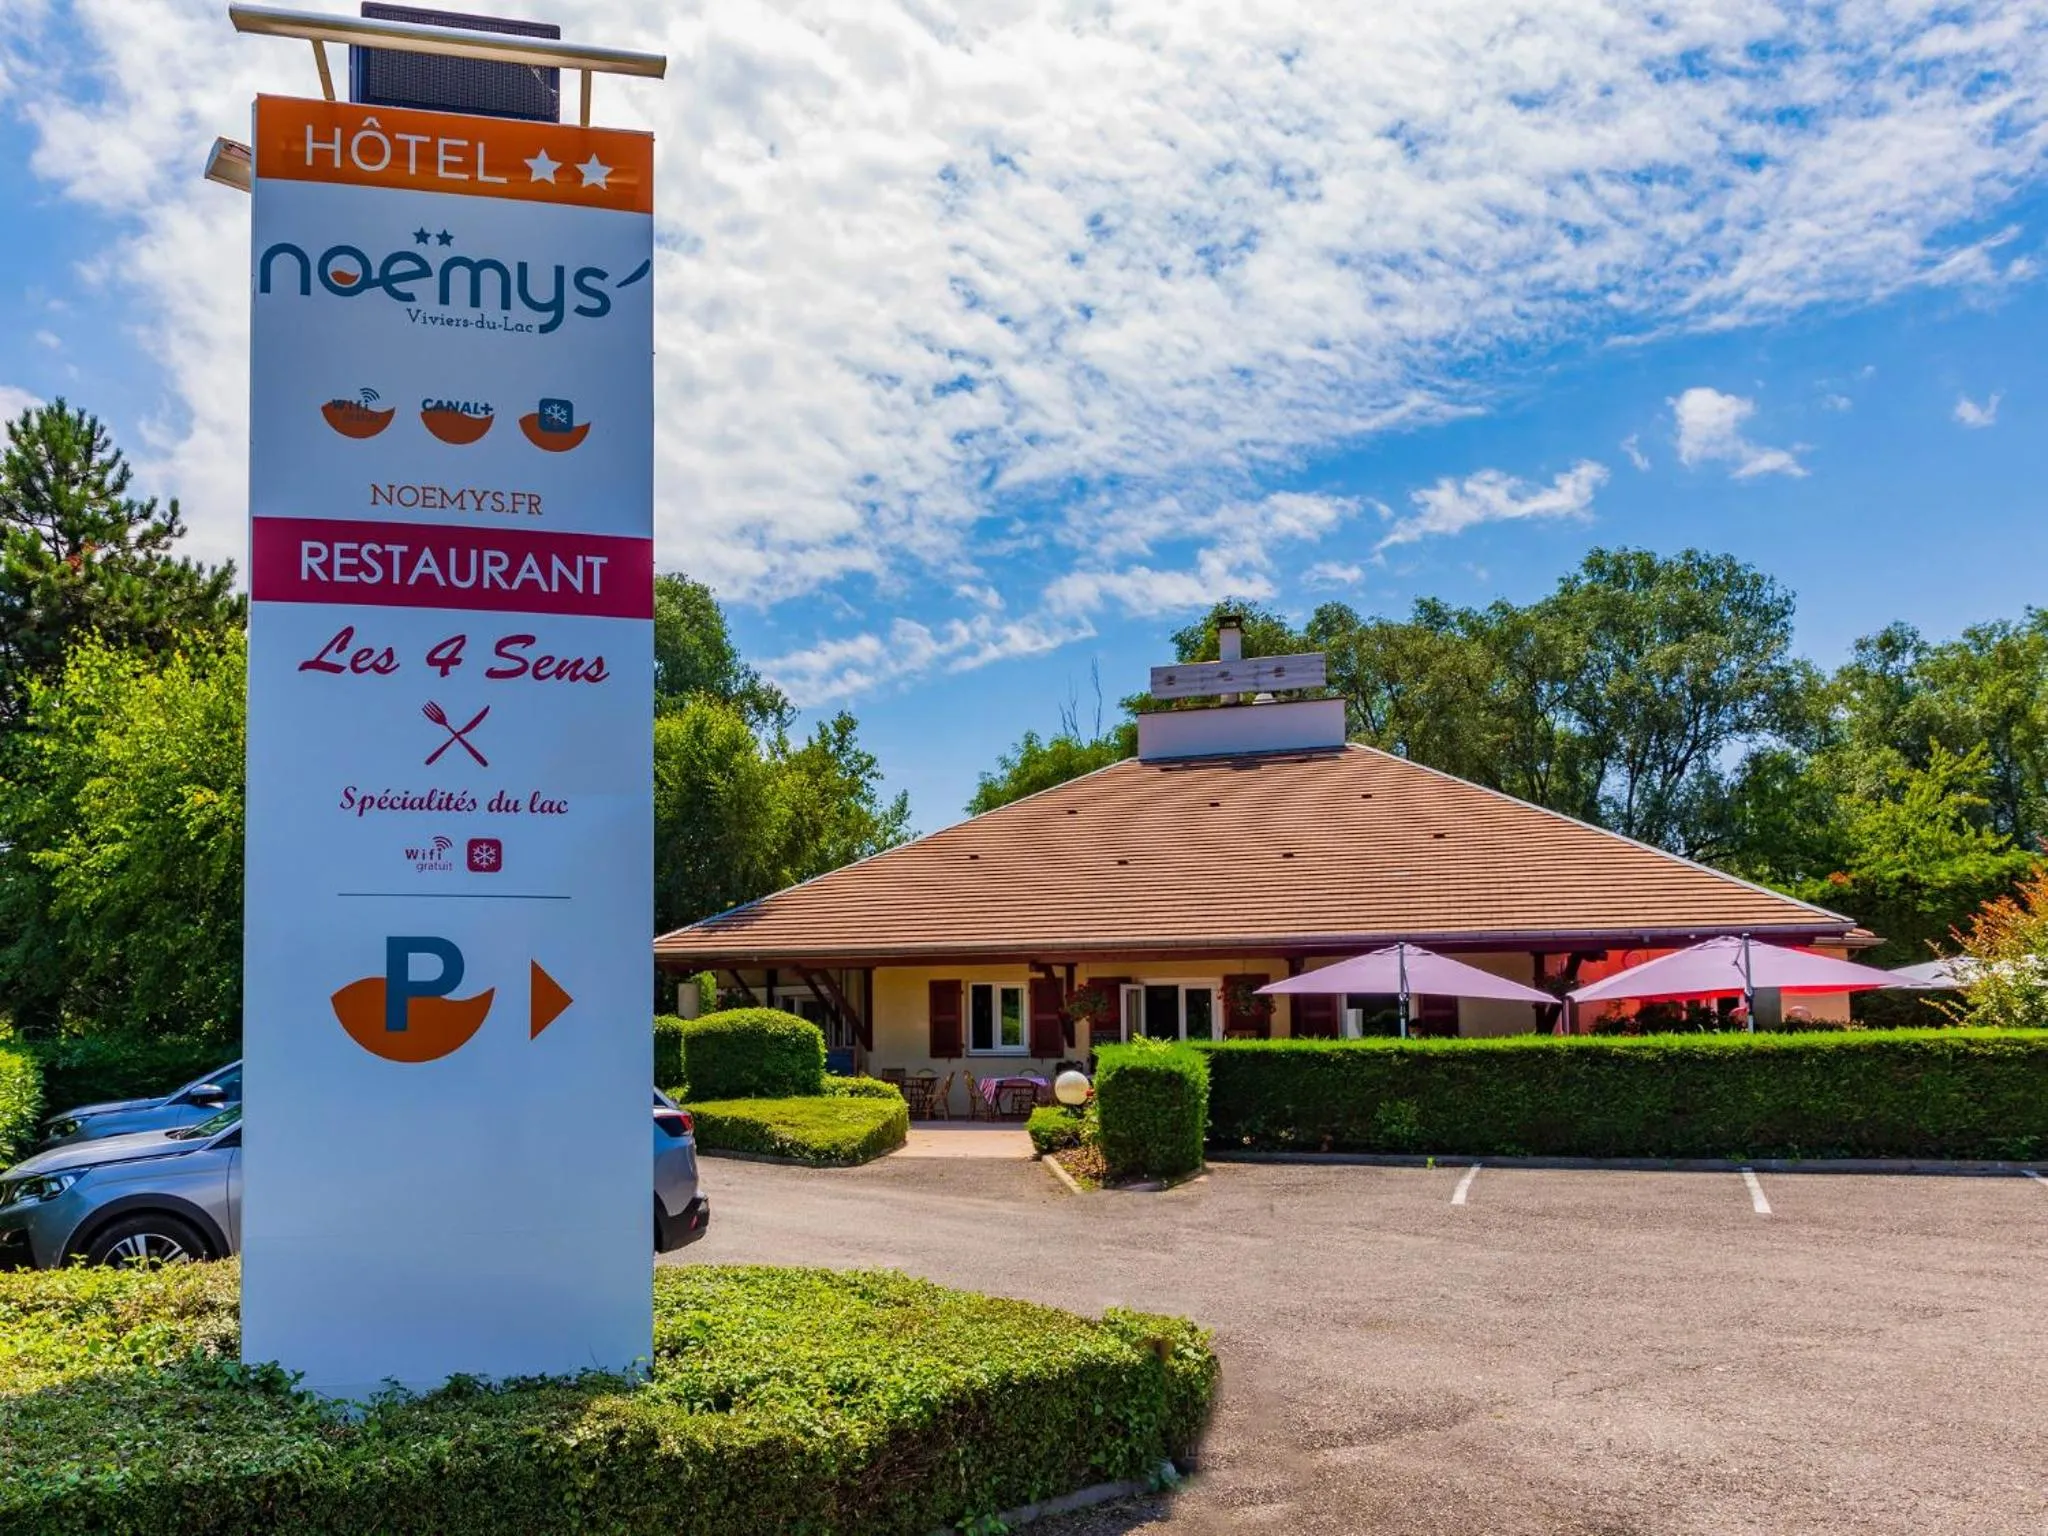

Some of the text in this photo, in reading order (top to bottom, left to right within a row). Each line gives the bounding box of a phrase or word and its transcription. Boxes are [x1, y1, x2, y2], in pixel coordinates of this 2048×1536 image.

[305, 117, 508, 184] HÔTEL
[406, 308, 533, 333] Viviers-du-Lac
[421, 398, 494, 415] CANAL+
[370, 484, 543, 515] NOEMYS.FR
[301, 540, 608, 595] RESTAURANT
[299, 625, 610, 683] Les 4 Sens
[339, 785, 569, 817] Spécialités du lac
[416, 861, 453, 873] gratuit
[385, 936, 464, 1032] P
